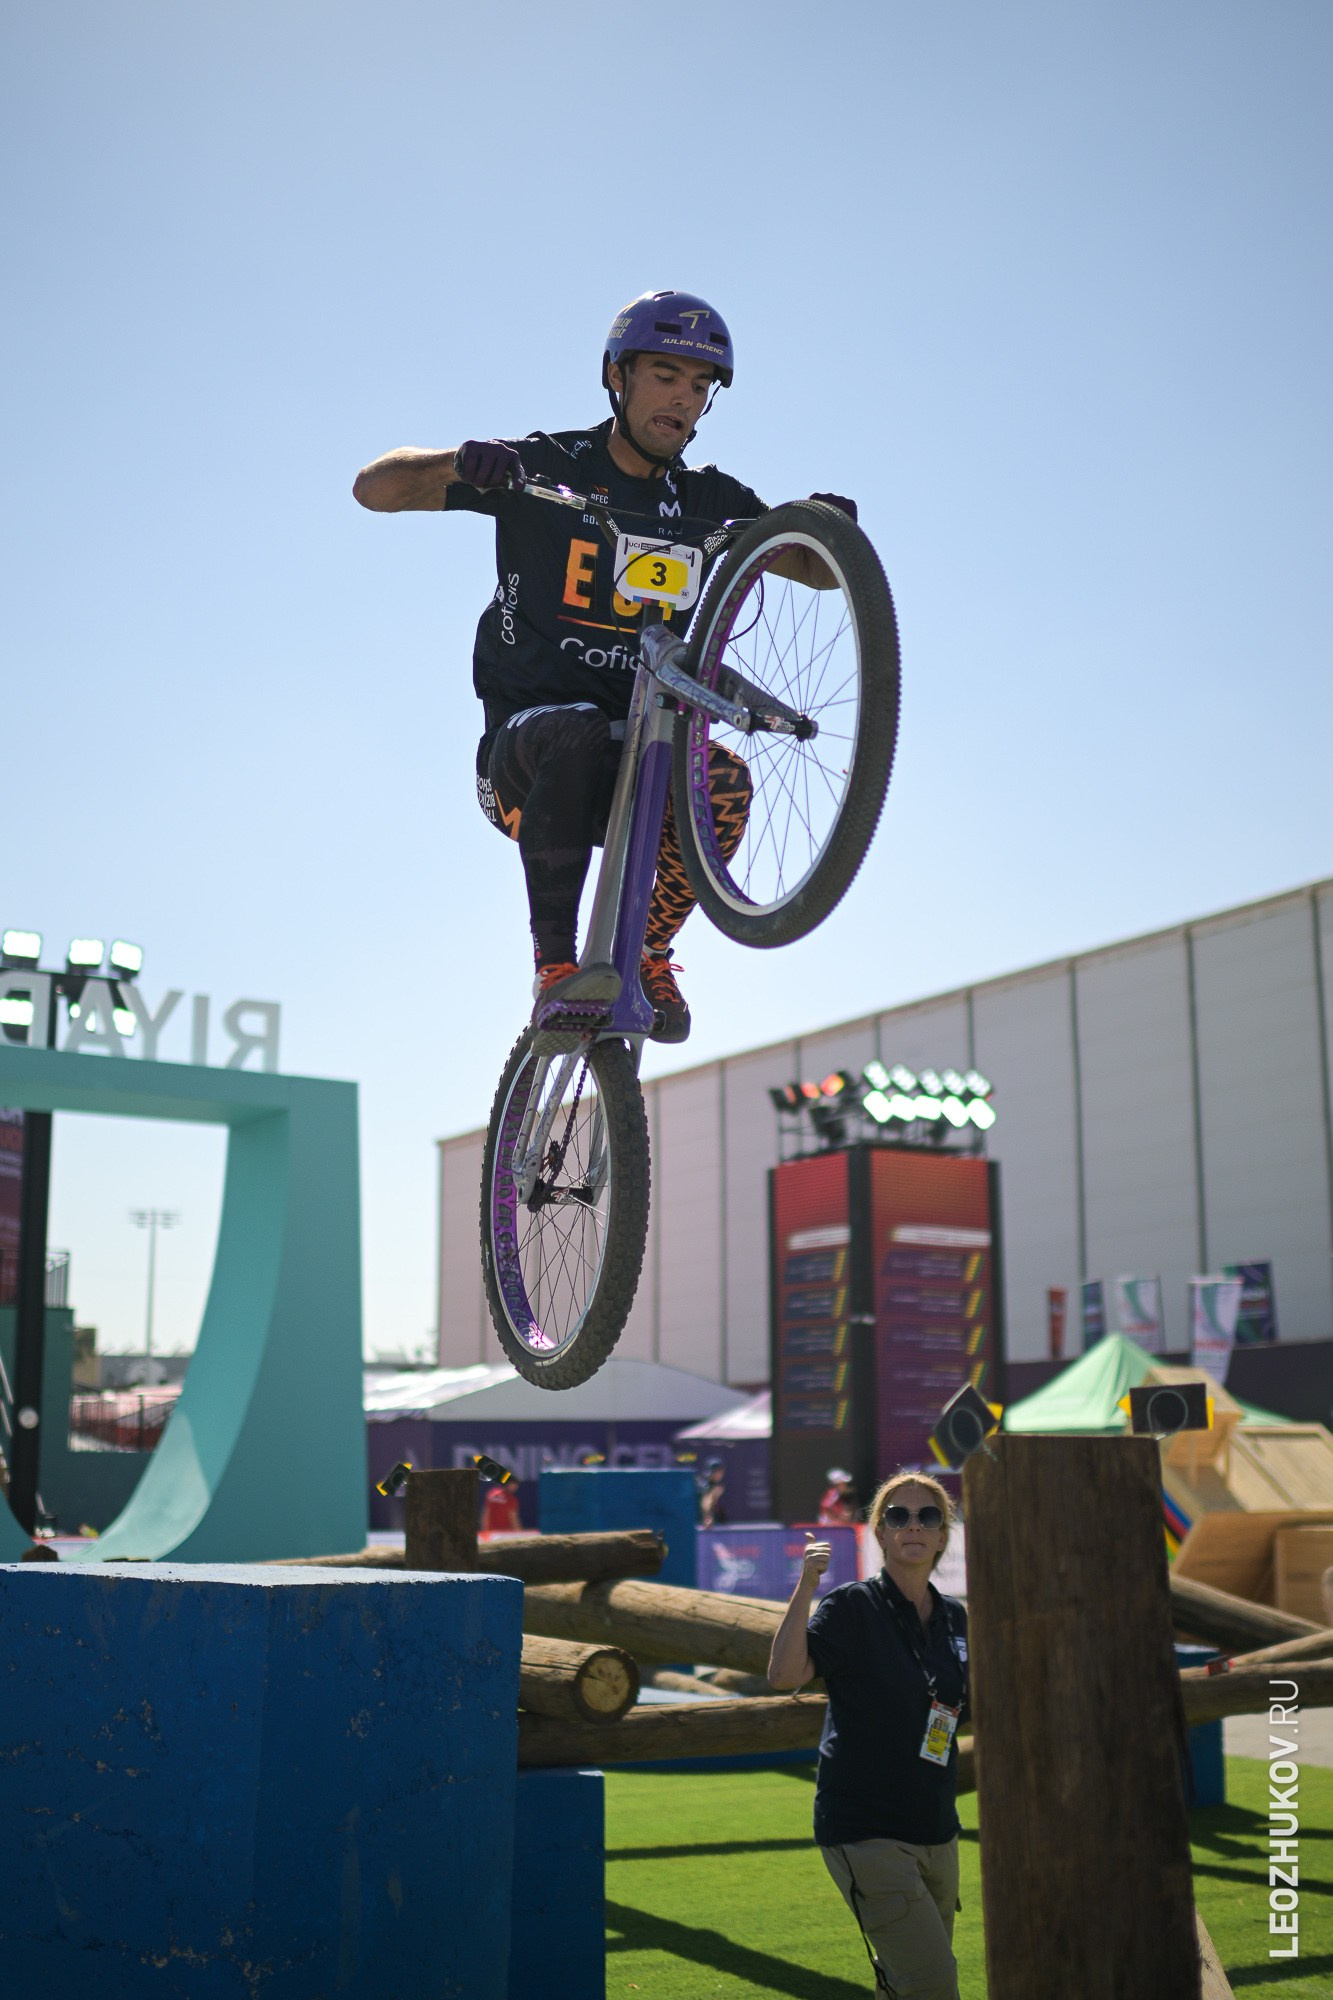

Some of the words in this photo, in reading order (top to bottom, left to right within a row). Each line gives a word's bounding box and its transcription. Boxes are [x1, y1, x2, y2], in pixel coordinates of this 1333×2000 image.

[661, 338, 694, 347] JULEN
[628, 541, 641, 549] UCI
[649, 561, 667, 587] 3
[501, 572, 520, 646] Cofidis
[559, 637, 641, 671] Cofi
